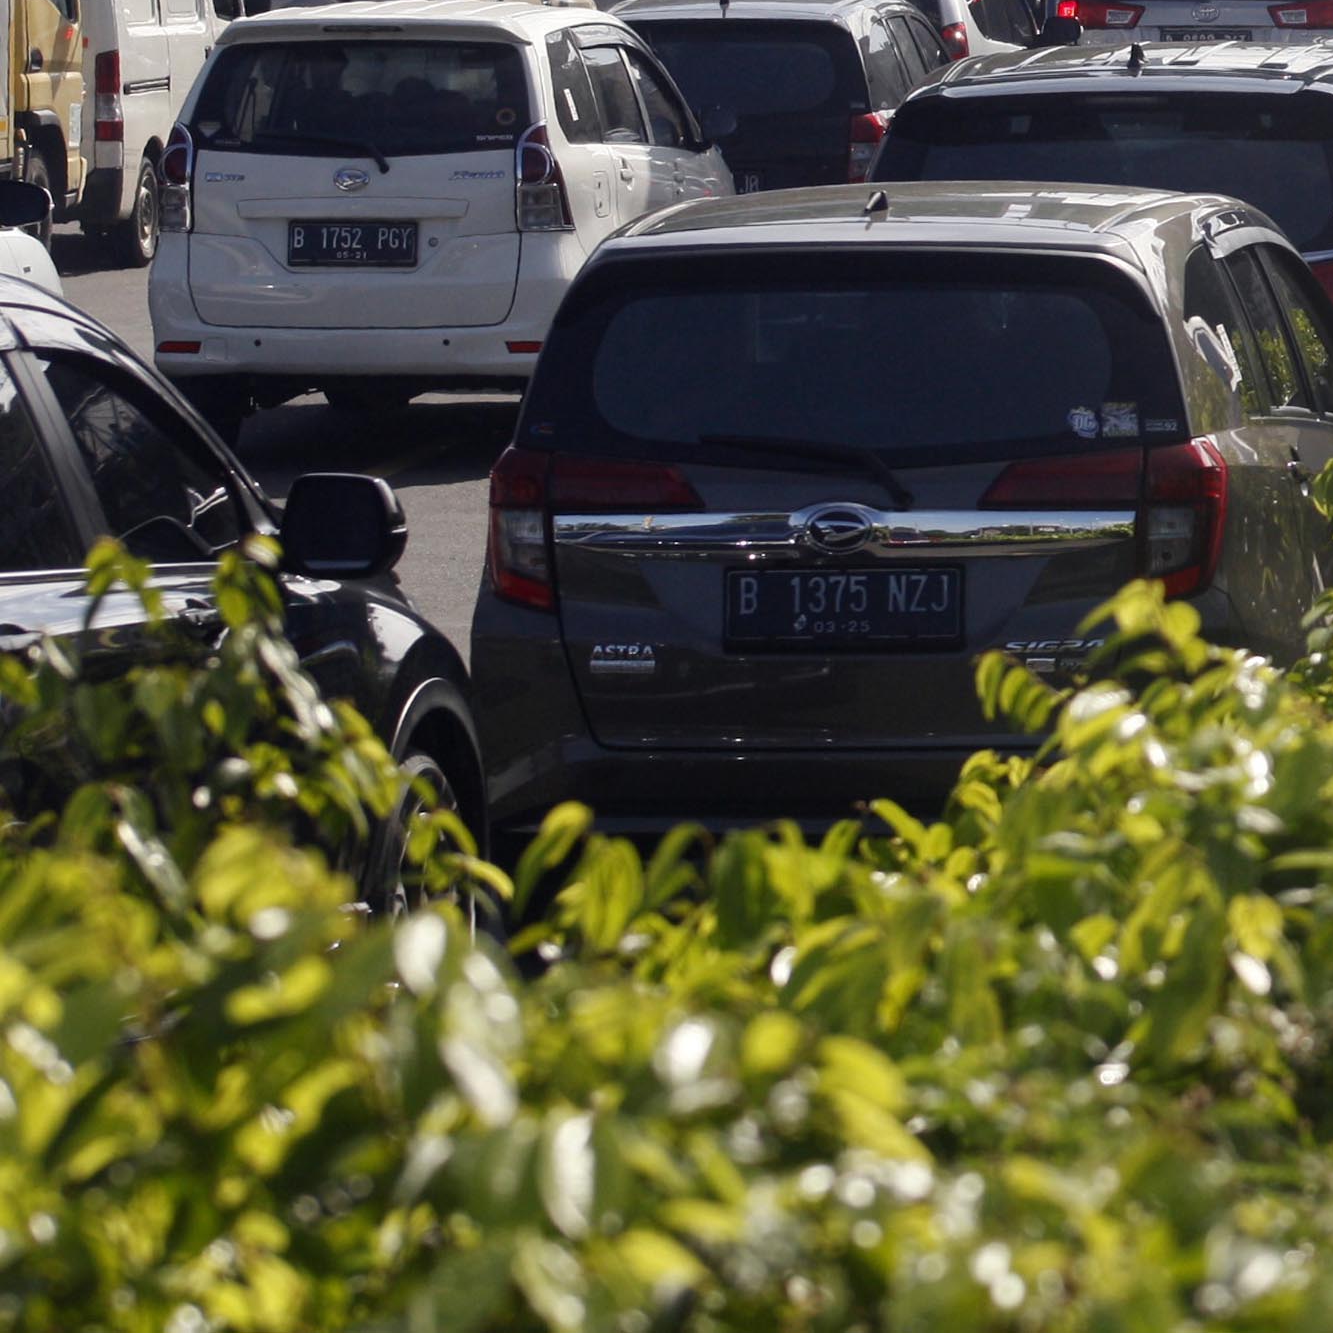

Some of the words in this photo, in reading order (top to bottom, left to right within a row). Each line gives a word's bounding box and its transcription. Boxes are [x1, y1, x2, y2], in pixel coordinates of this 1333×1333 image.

[293, 228, 304, 248] B
[320, 227, 362, 248] 1752
[377, 227, 412, 249] PGY
[740, 577, 758, 615] B
[790, 576, 867, 613] 1375
[888, 575, 949, 613] NZJ
[592, 644, 656, 659] ASTRA
